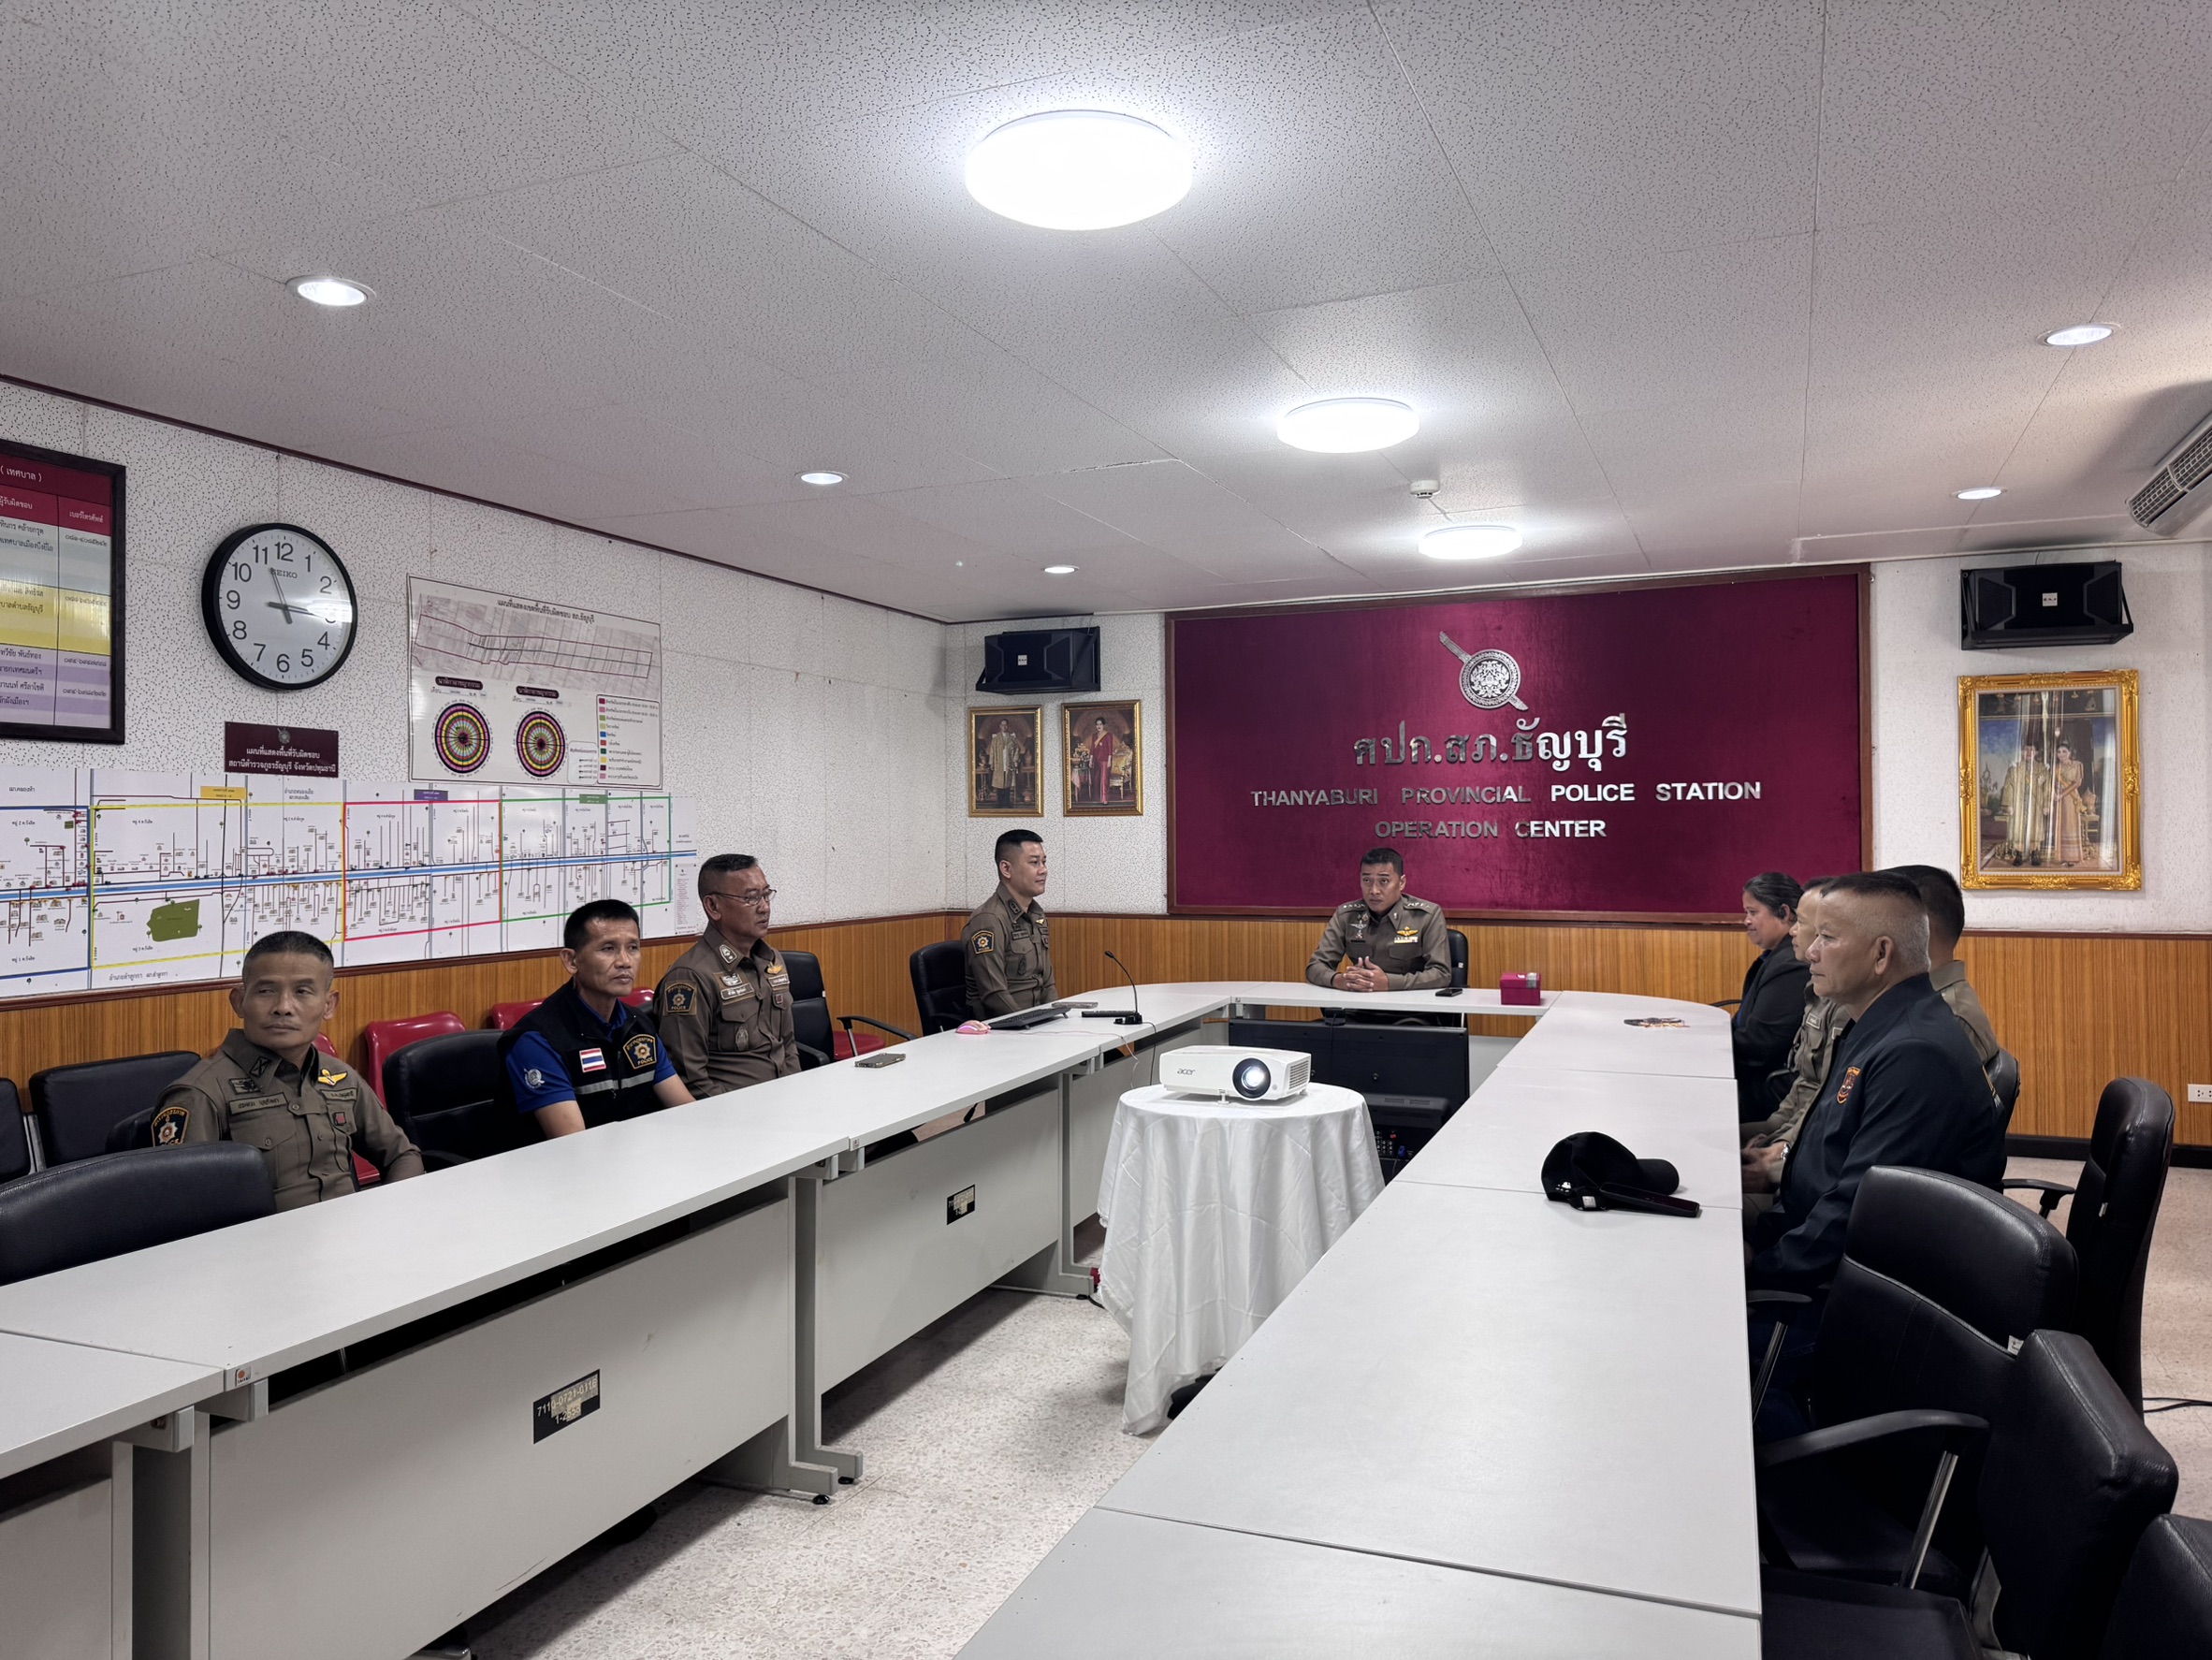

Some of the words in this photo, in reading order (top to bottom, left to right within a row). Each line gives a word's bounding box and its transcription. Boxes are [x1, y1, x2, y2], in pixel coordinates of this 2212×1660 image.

[7, 467, 36, 481] เทศบาล
[253, 545, 268, 565] 11
[274, 542, 294, 562] 12
[232, 561, 252, 583] 10
[305, 554, 312, 573] 1
[271, 568, 298, 579] SEIKO
[319, 575, 332, 595] 2
[226, 590, 240, 610] 9
[232, 619, 247, 640] 8
[317, 631, 330, 650] 4
[253, 643, 267, 662] 7
[300, 648, 313, 667] 5
[276, 653, 290, 673] 6
[246, 744, 320, 759] แผนที่แสดงพื้นที่รับผิดชอบ
[1353, 713, 1628, 772] ศปก.สภ.ธัญบุรี
[228, 758, 292, 773] สถานีตำรวจภูธรธัญบุรี
[1250, 788, 1378, 807] THANYABURI
[1402, 786, 1531, 805] PROVINCIAL
[1550, 783, 1636, 802] POLICE
[1655, 781, 1761, 802] STATION
[1375, 821, 1498, 838] OPERATION
[1514, 820, 1608, 837] CENTER
[1176, 1068, 1197, 1076] acer
